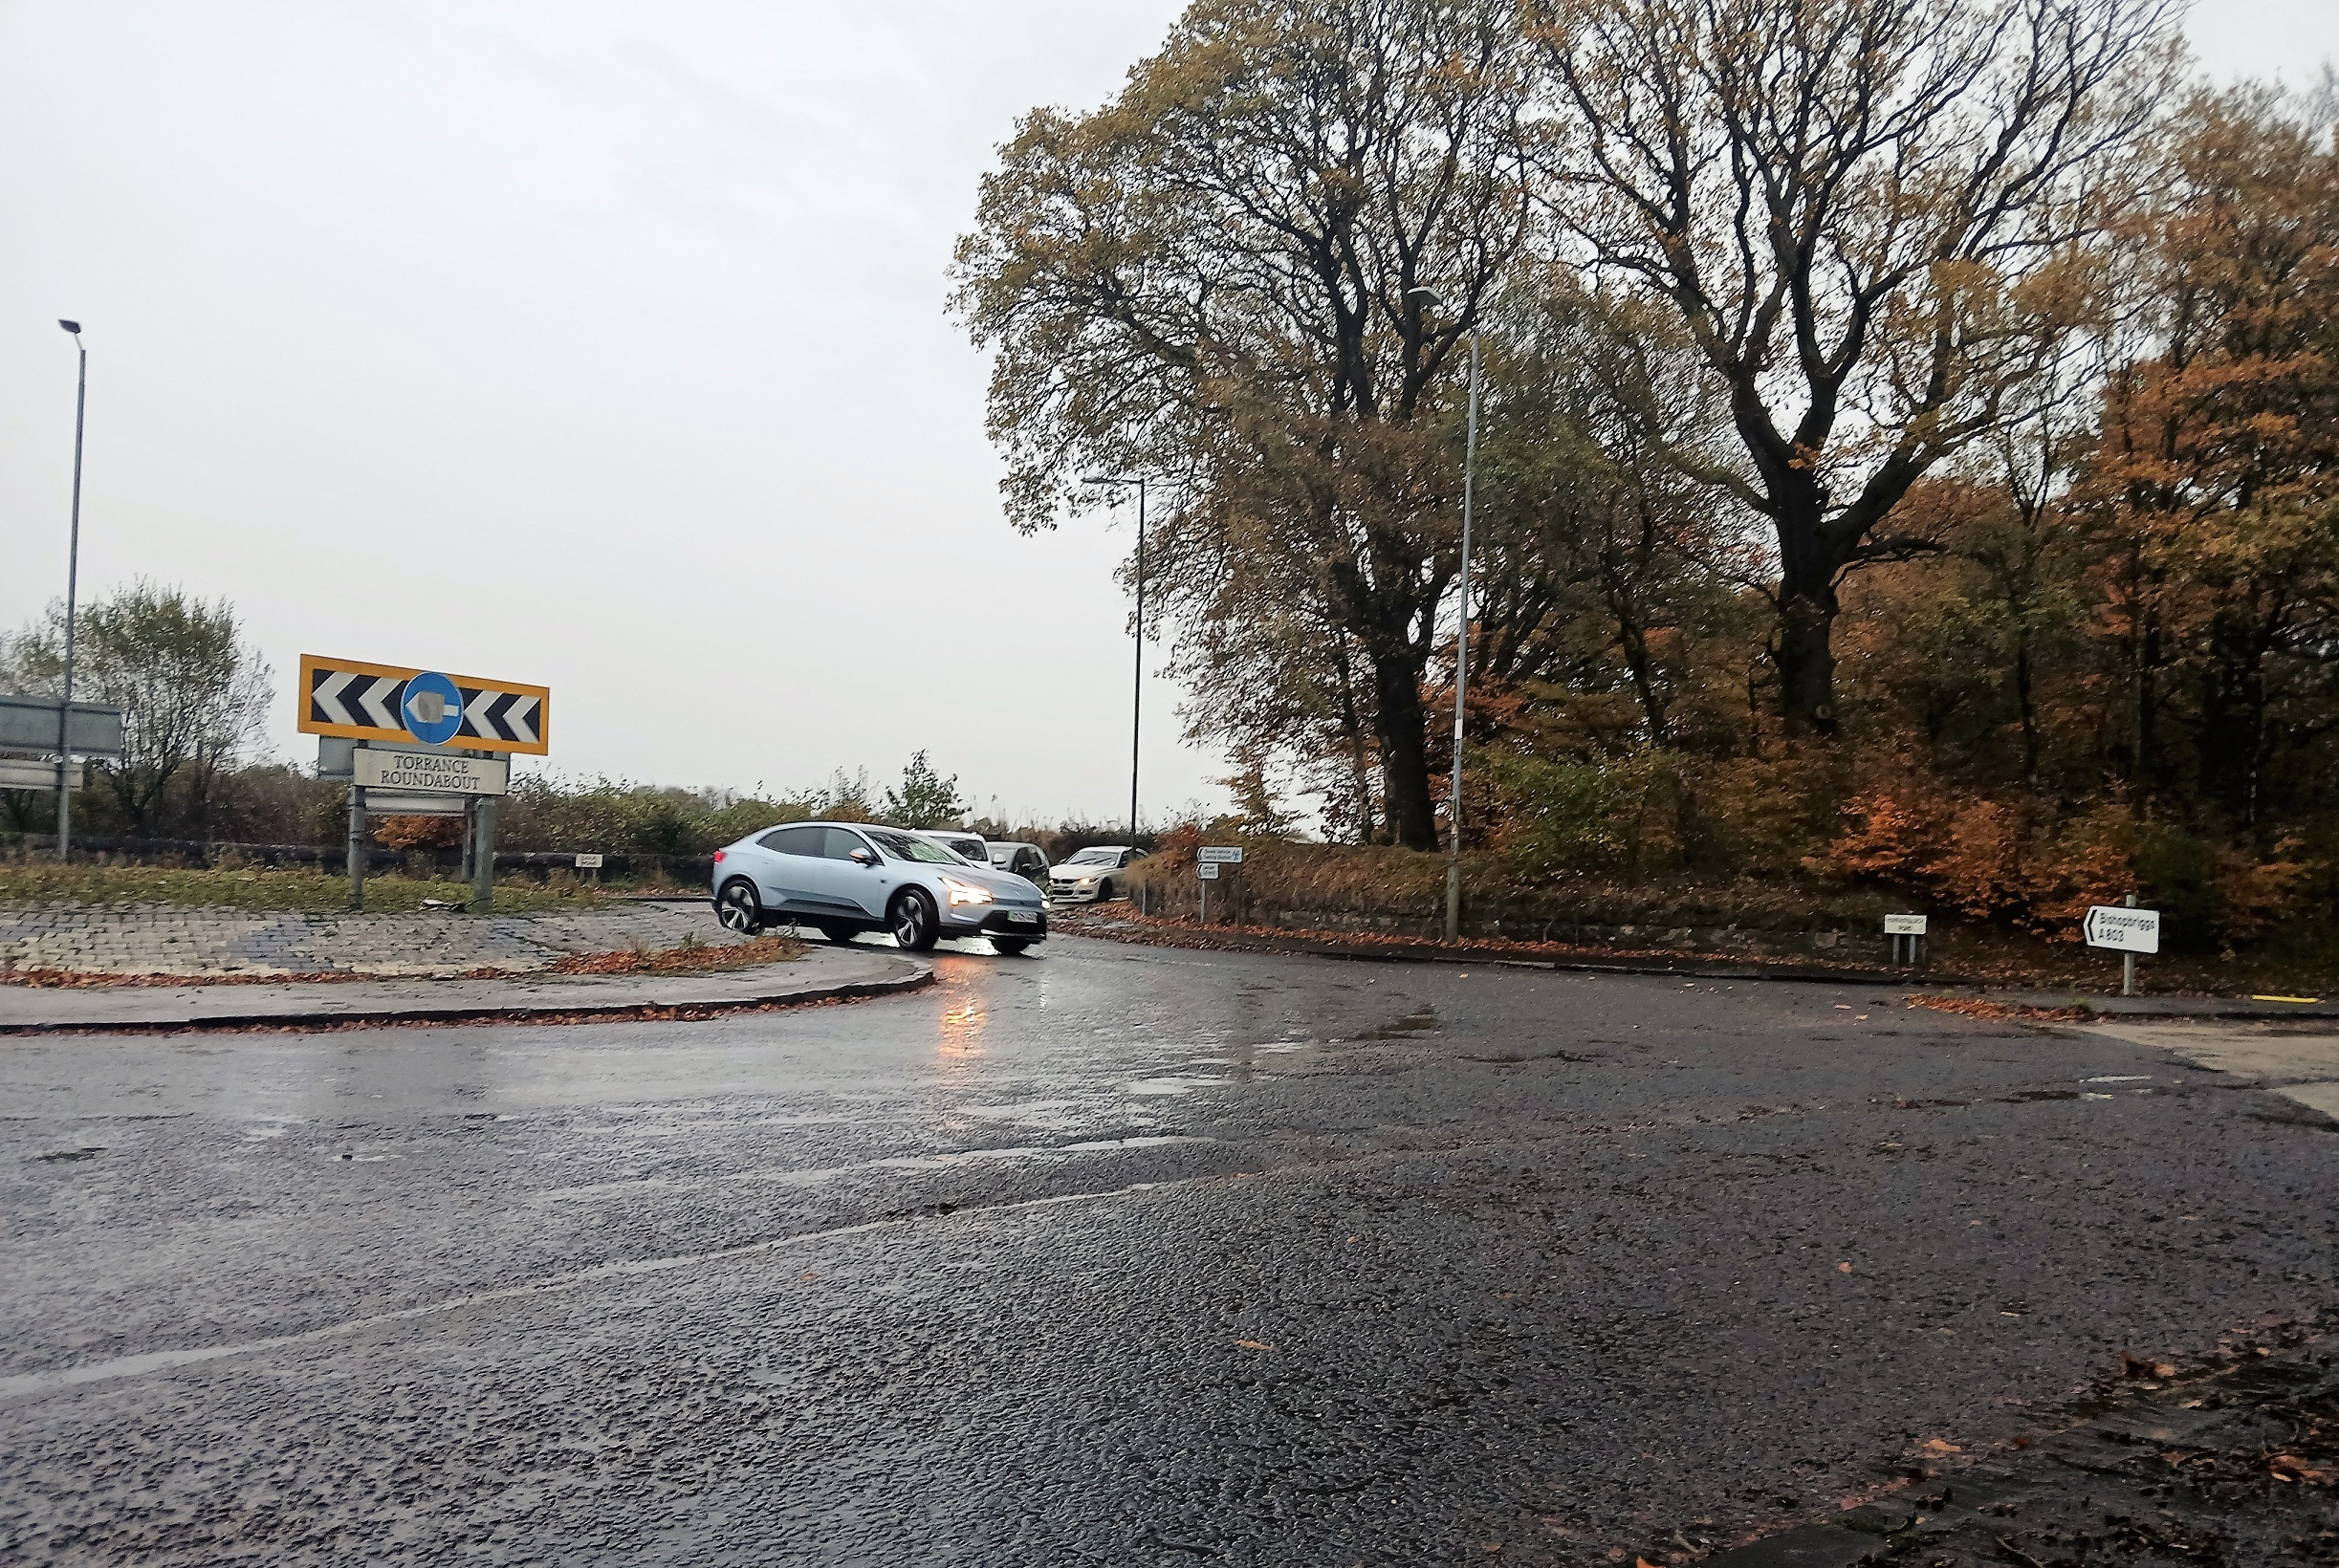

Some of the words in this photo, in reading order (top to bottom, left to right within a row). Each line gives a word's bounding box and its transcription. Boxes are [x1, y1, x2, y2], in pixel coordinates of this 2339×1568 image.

[394, 755, 470, 773] TORRANCE
[381, 771, 481, 790] ROUNDABOUT
[2099, 912, 2155, 931] Bishopbriggs
